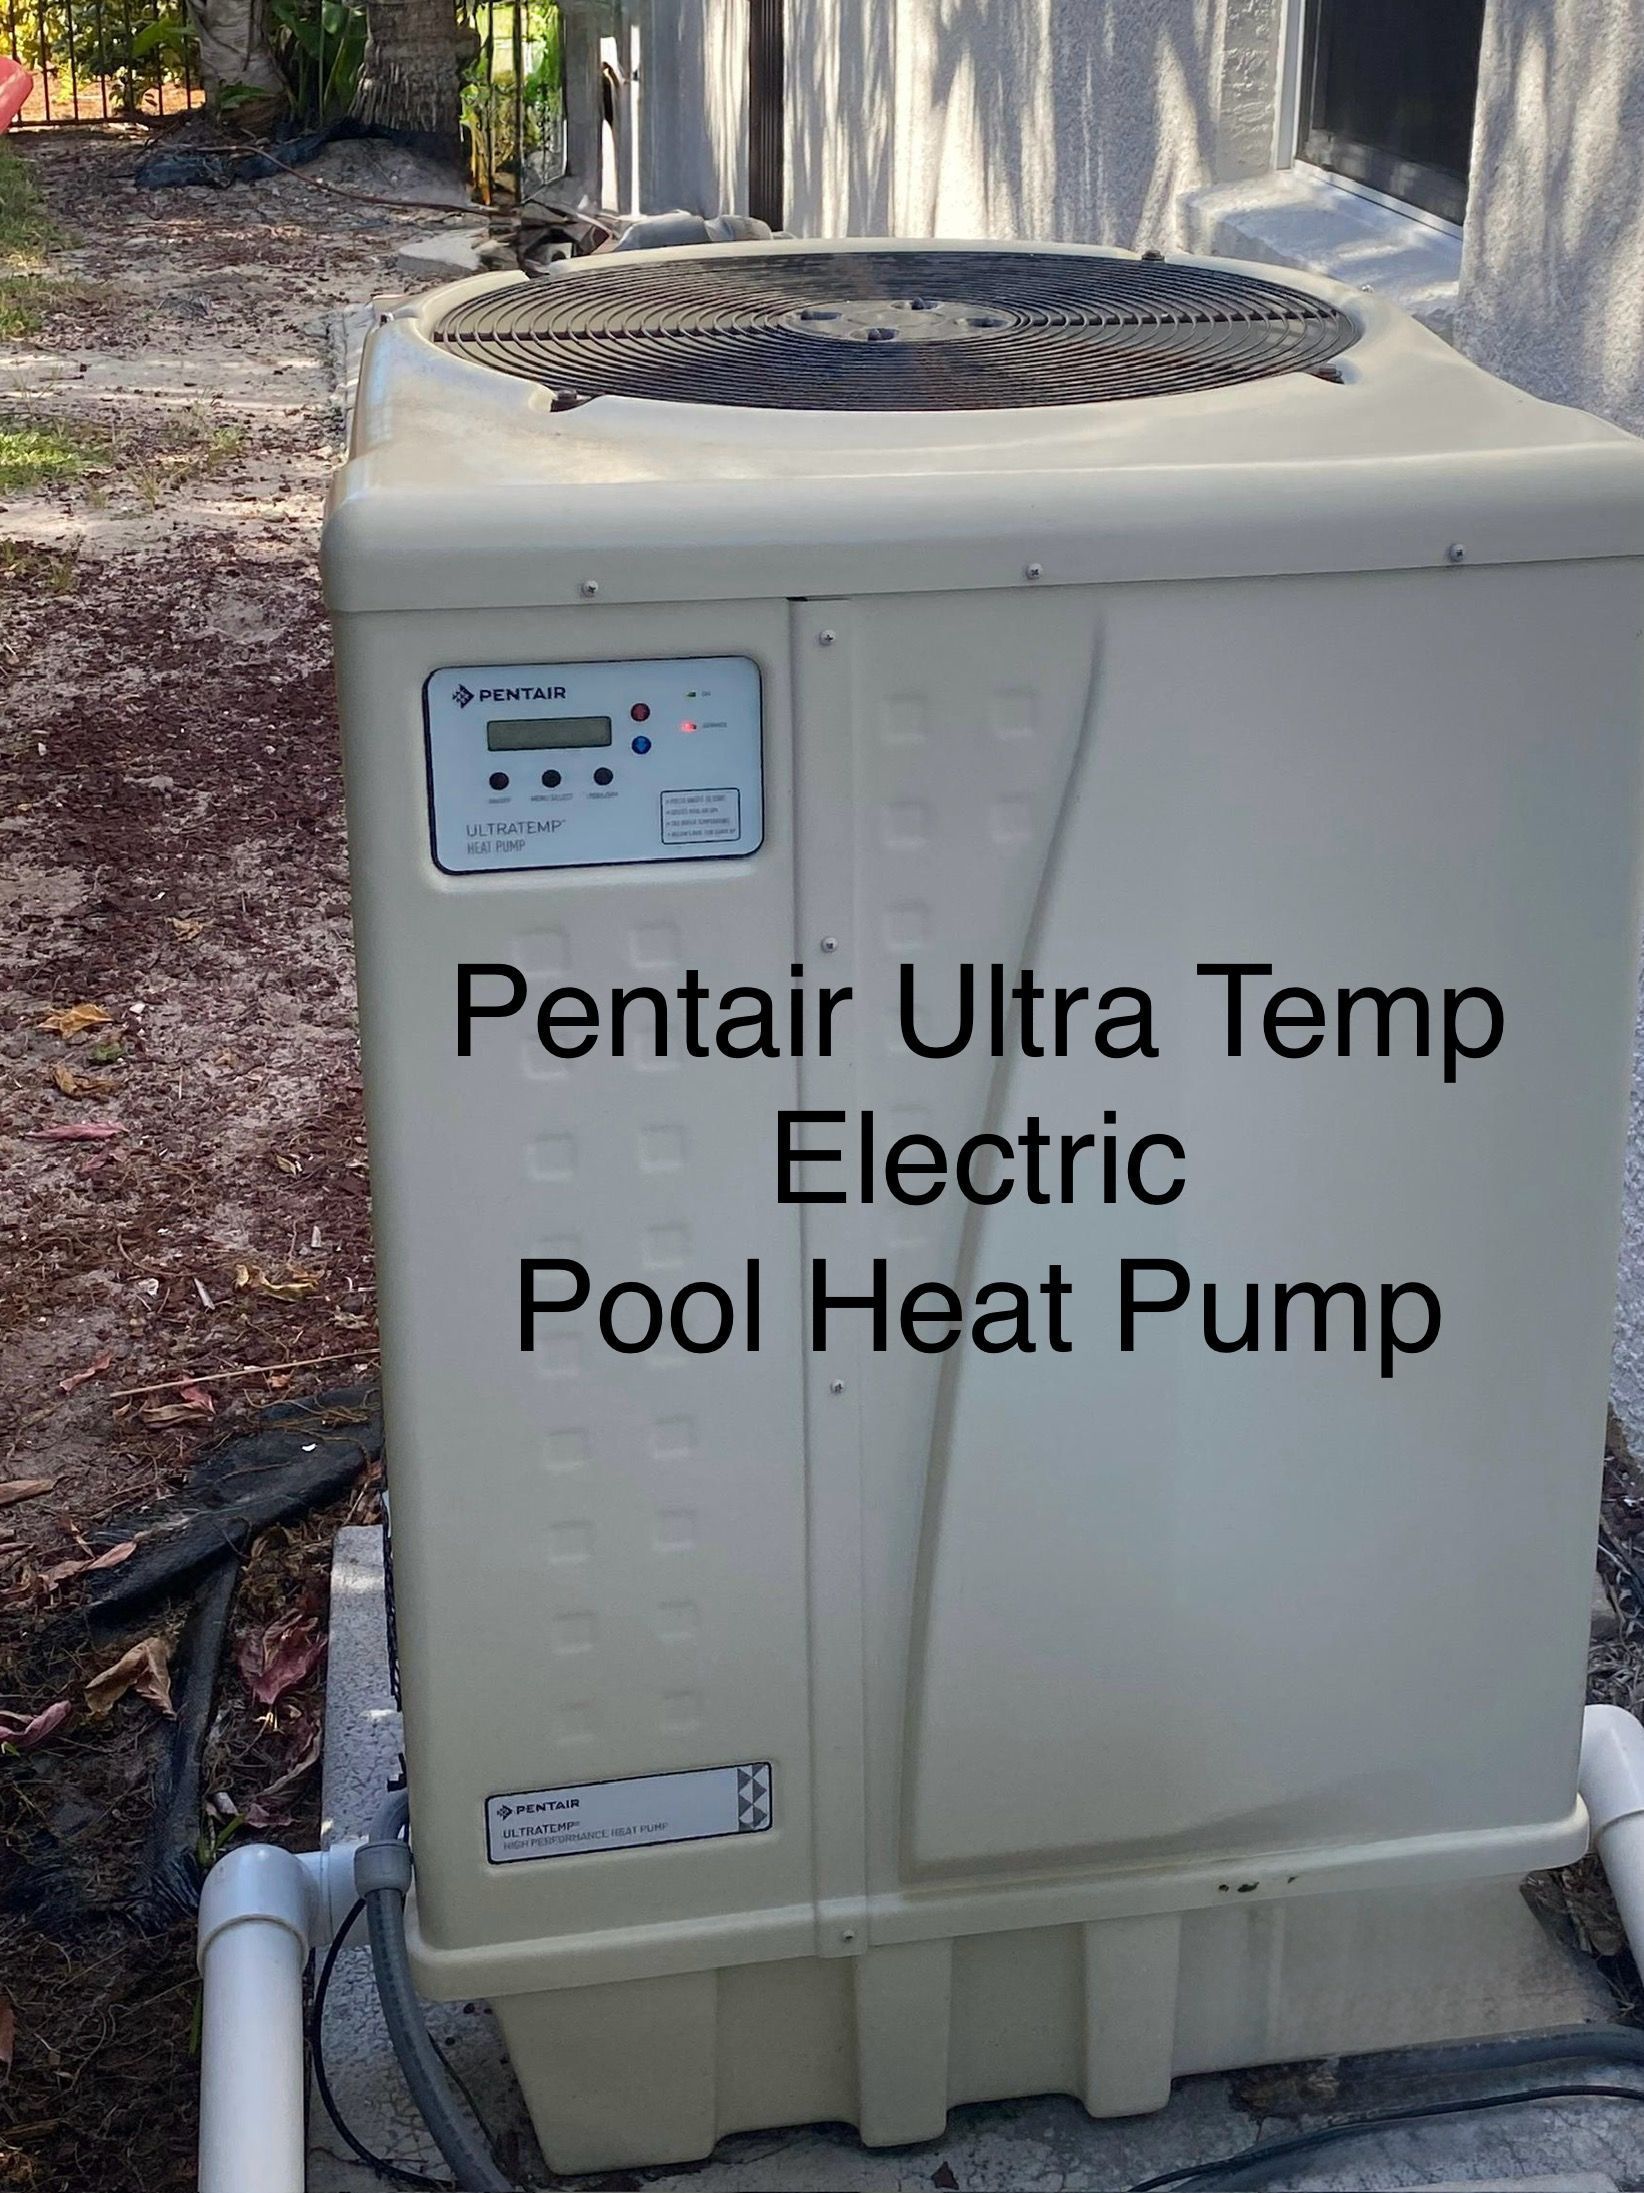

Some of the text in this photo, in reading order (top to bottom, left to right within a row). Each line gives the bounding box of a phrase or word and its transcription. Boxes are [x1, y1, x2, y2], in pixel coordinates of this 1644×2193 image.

[479, 686, 567, 702] PENTAIR
[467, 839, 526, 854] HEAT PUMP
[516, 1799, 580, 1815] PENTAIR
[504, 1822, 669, 1850] HIGH PERFORMANCE HEAT PUMP
